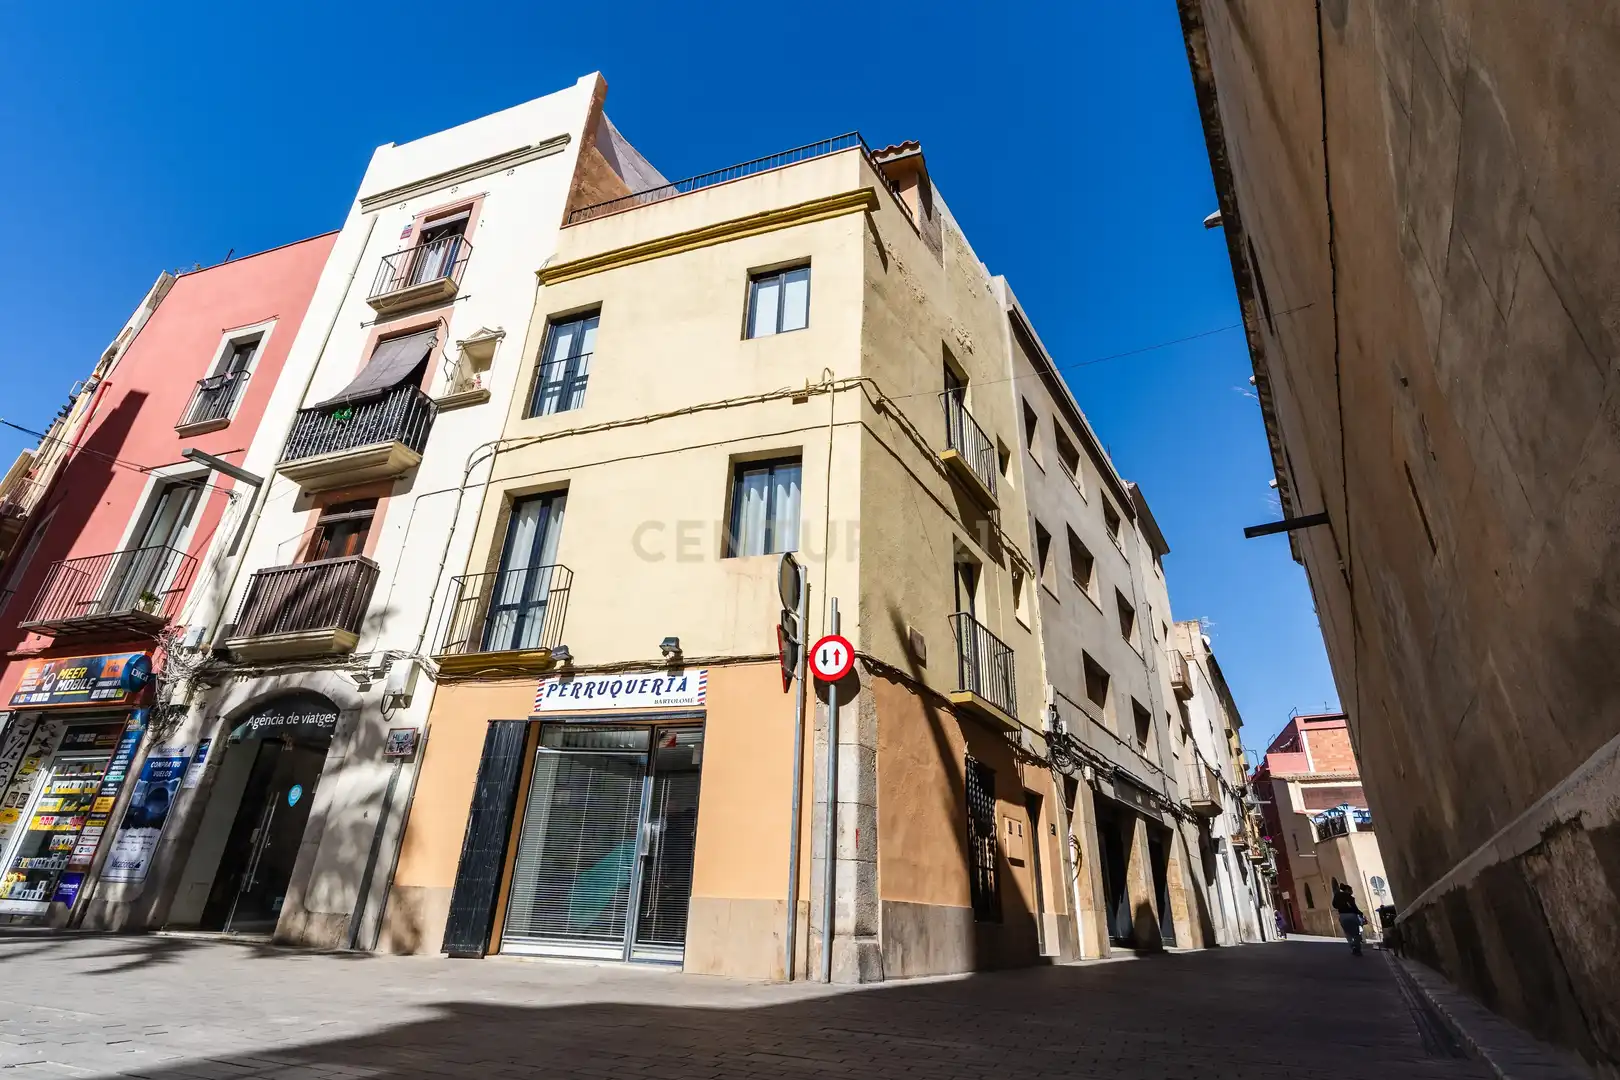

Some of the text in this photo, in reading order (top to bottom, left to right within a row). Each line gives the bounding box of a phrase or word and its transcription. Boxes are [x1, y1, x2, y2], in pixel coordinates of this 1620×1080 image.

[57, 667, 87, 680] MEER
[131, 668, 148, 681] DIGI
[55, 678, 95, 691] MOBILE
[246, 711, 336, 730] Agència de viatges
